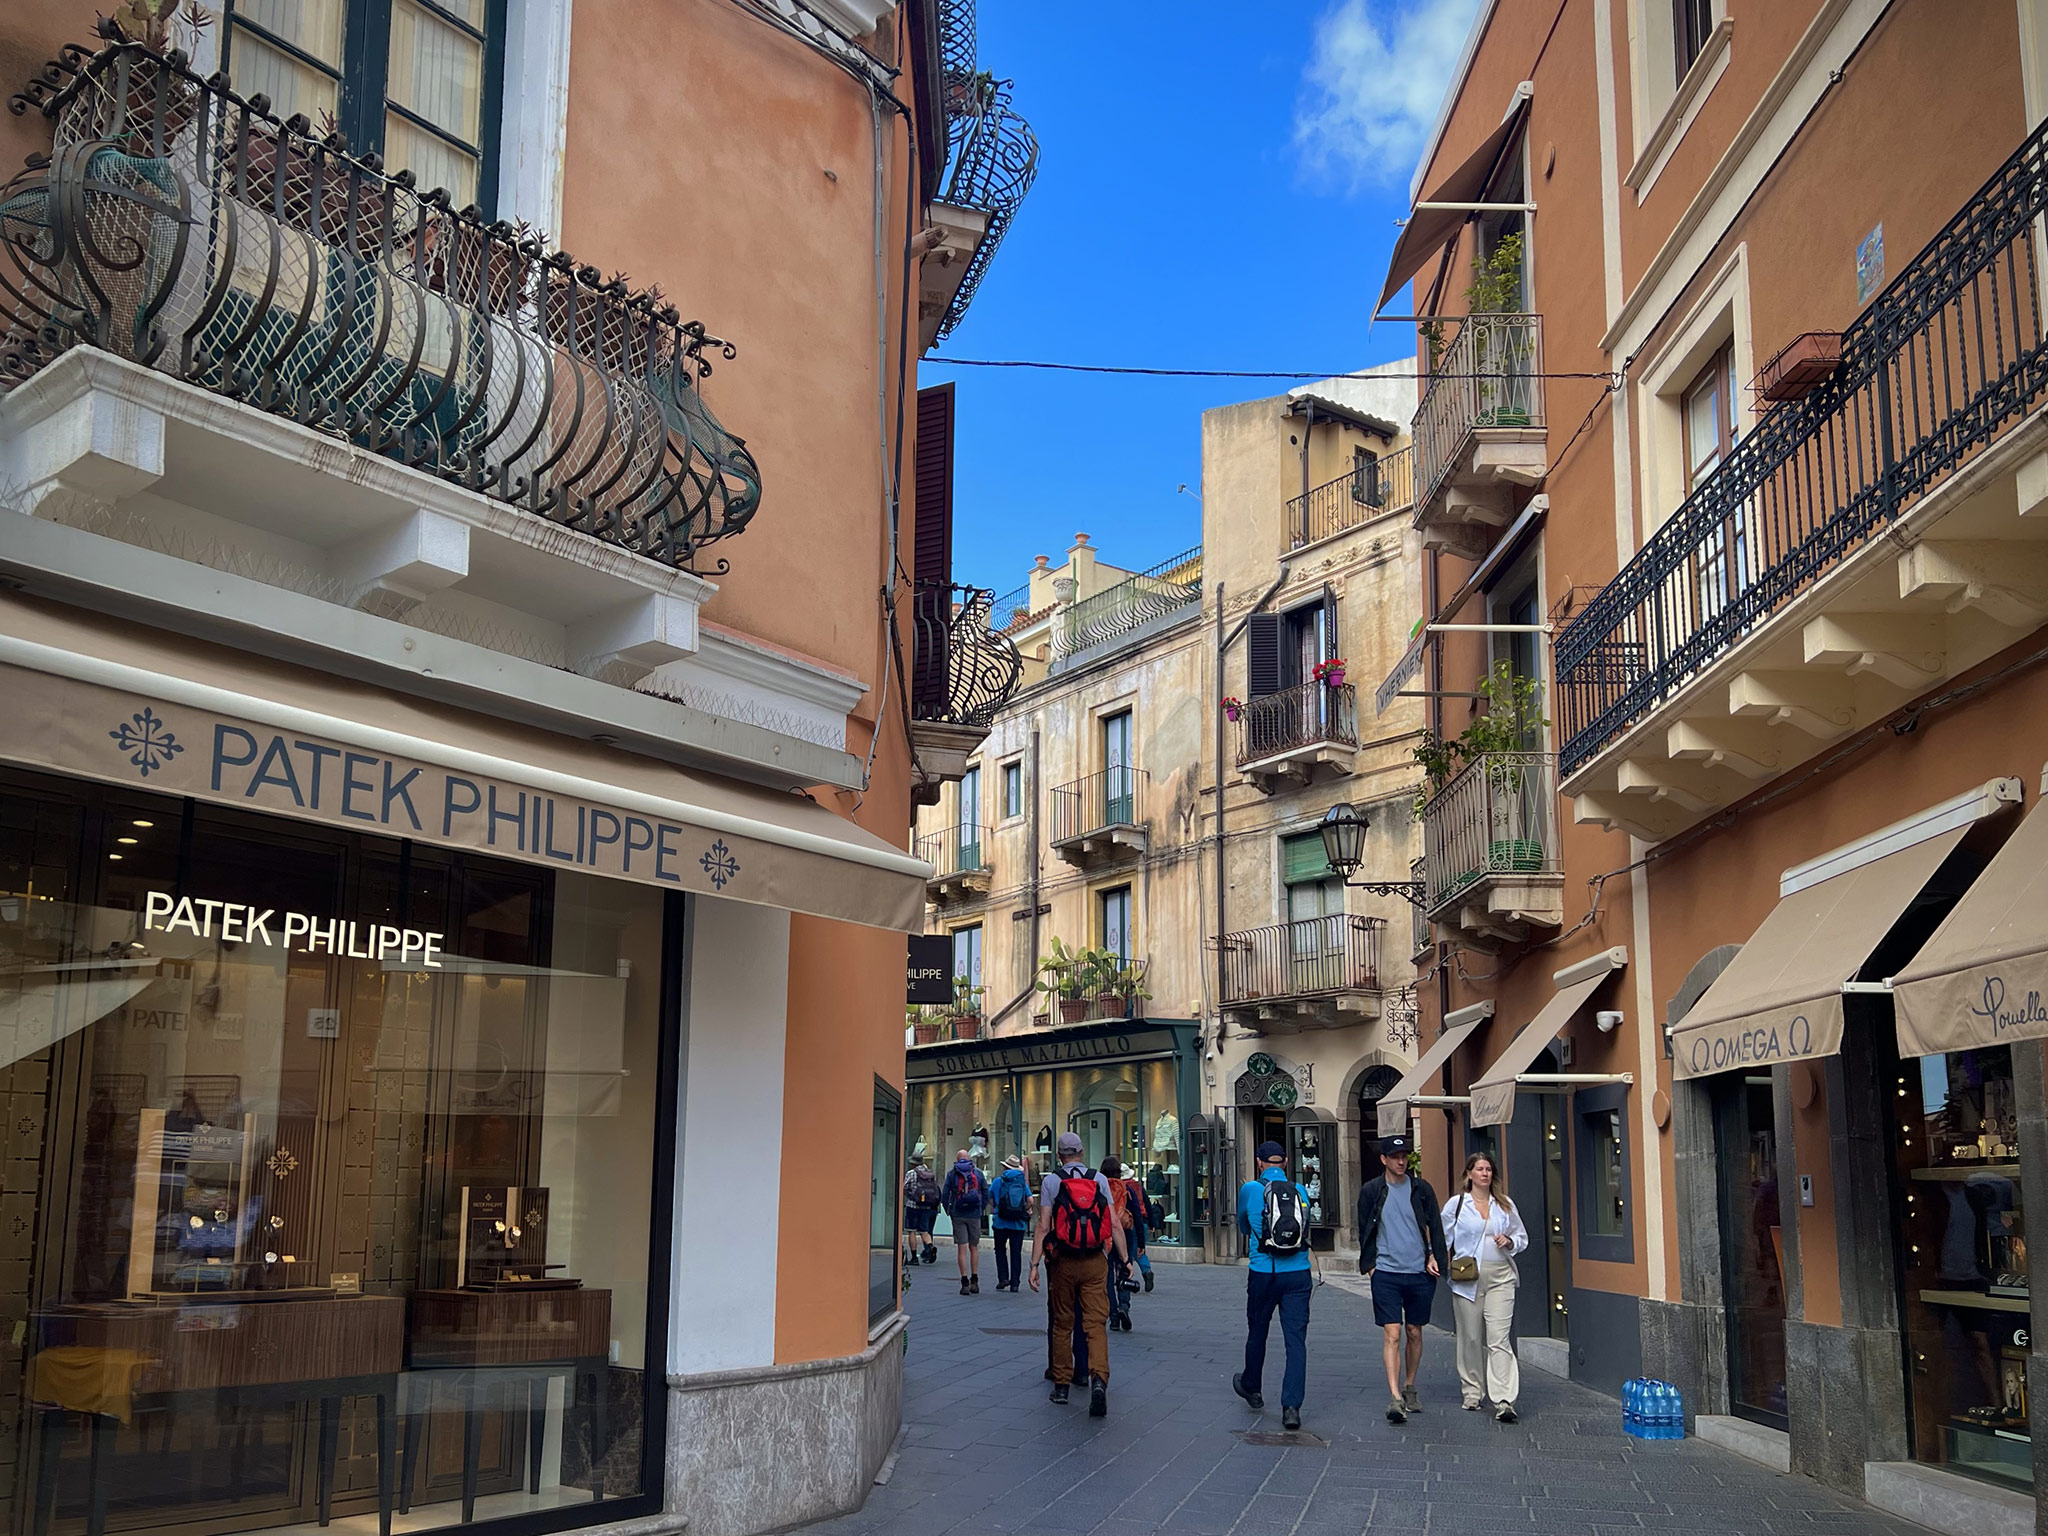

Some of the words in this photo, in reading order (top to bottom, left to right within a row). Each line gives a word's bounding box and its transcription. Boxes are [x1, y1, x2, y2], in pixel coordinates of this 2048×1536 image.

[1380, 647, 1421, 708] VHERNIER
[211, 723, 424, 831] PATEK
[442, 775, 683, 883] PHILIPPE
[145, 890, 275, 946] PATEK
[283, 911, 444, 968] PHILIPPE
[936, 1052, 1011, 1073] SORELLE
[1021, 1036, 1131, 1064] MAZZULLO
[1713, 1027, 1781, 1068] OMEGA
